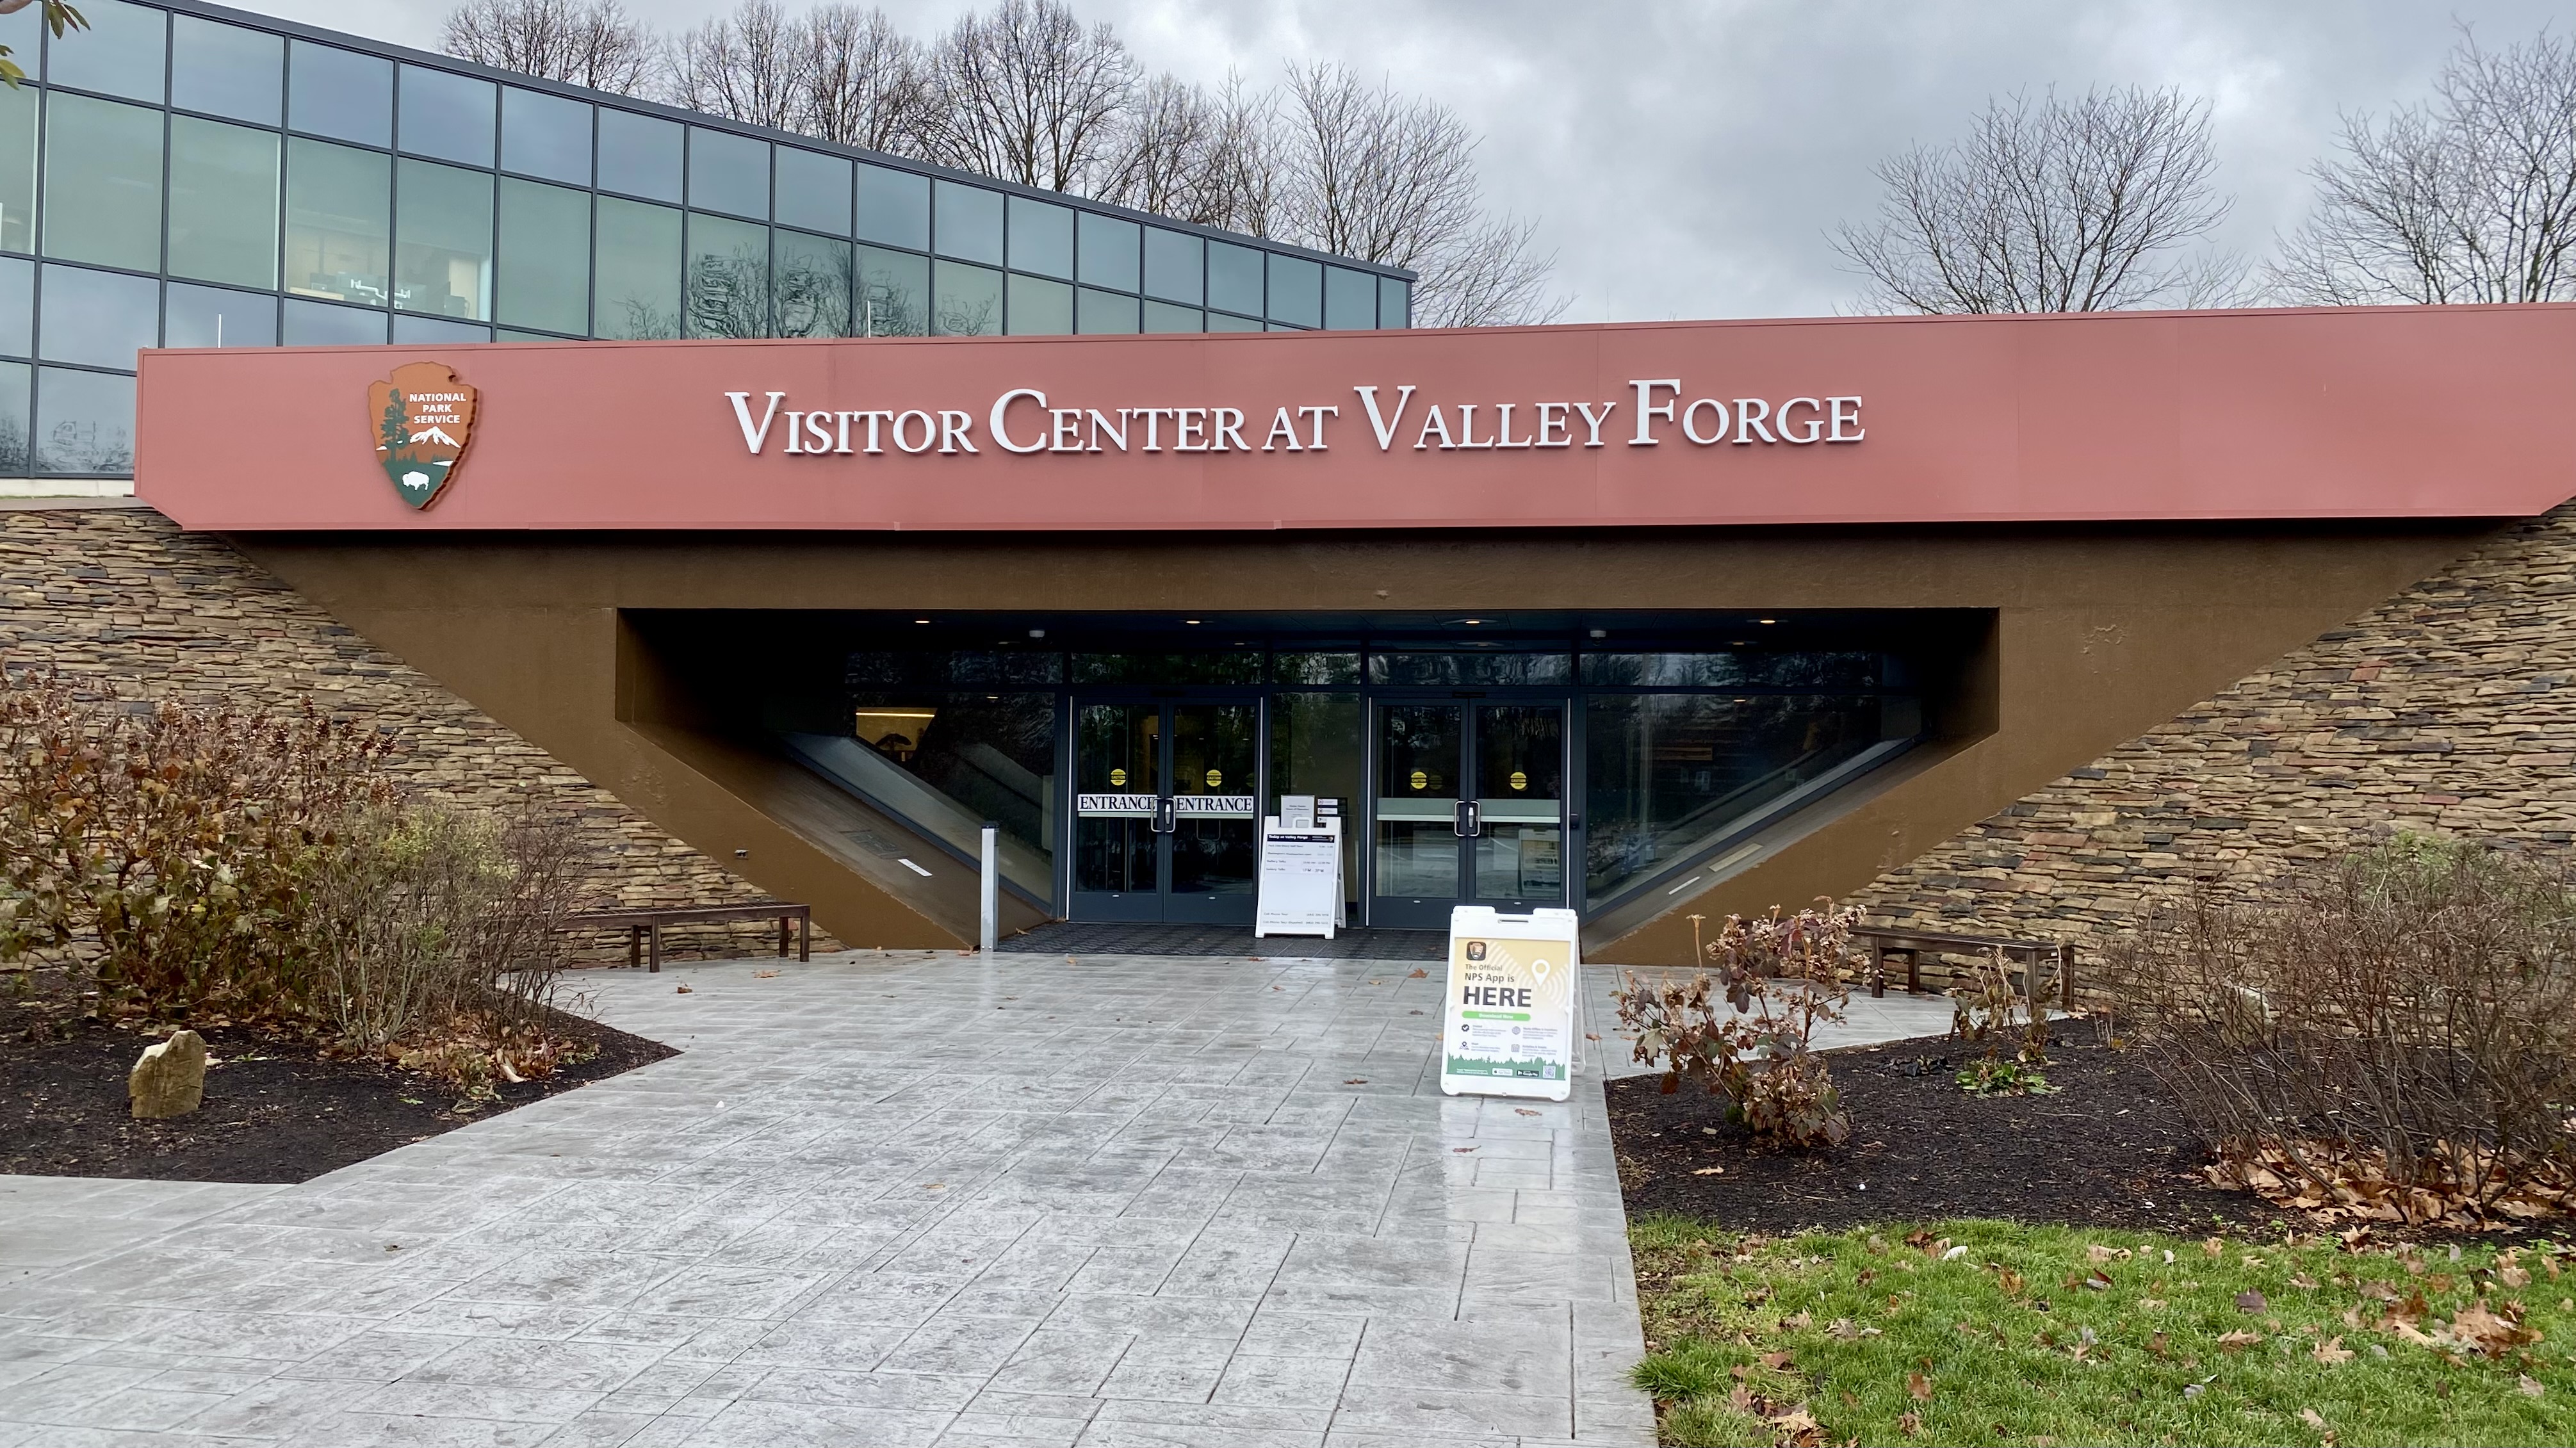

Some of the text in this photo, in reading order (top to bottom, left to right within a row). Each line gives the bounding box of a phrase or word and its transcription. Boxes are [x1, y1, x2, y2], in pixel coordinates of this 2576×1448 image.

[409, 393, 467, 402] NATIONAL
[423, 404, 452, 413] PARK
[414, 415, 461, 424] SERVICE
[724, 378, 1866, 454] VISITOR CENTER AT VALLEY FORGE
[1080, 796, 1155, 809] ENTRANCE
[1177, 797, 1252, 811] ENTRANCE
[1465, 973, 1515, 984] NPS App is
[1463, 986, 1531, 1007] HERE
